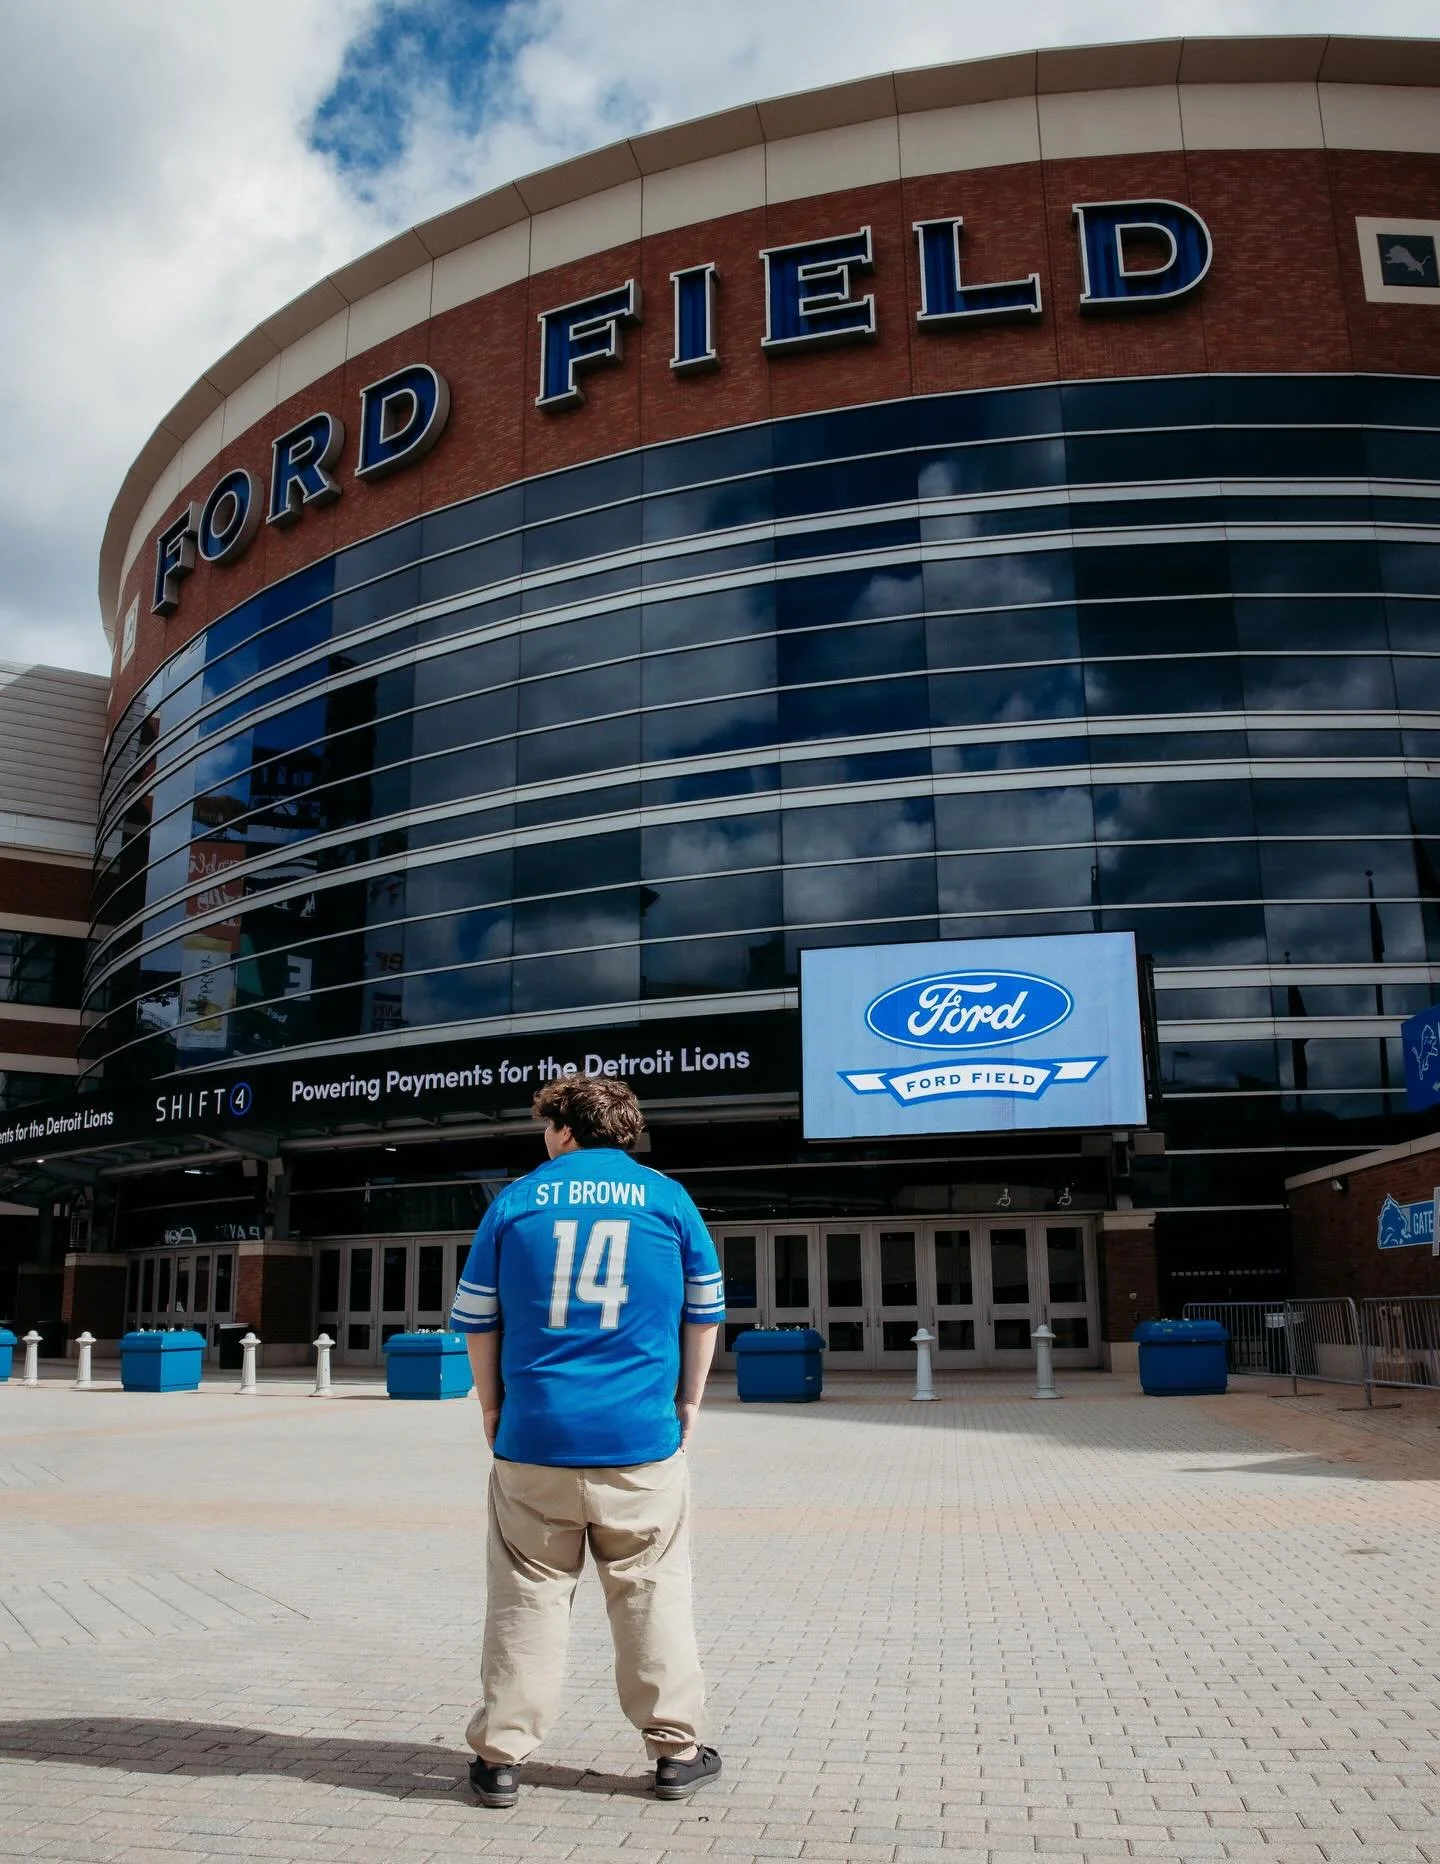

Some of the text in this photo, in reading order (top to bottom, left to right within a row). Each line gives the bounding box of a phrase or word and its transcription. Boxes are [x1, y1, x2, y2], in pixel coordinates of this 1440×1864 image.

[151, 198, 1213, 617] FORD FIELD
[907, 981, 1029, 1037] Ford
[291, 1046, 751, 1102] Powering Payments for the Detroit Lions
[906, 1072, 1036, 1093] FORD FIELD
[15, 1122, 29, 1142] for
[29, 1119, 45, 1139] the
[46, 1111, 82, 1136] Detroit
[84, 1108, 114, 1129] Lions
[535, 1180, 646, 1207] ST BROWN
[1413, 1209, 1434, 1236] GATE
[548, 1219, 631, 1330] 14
